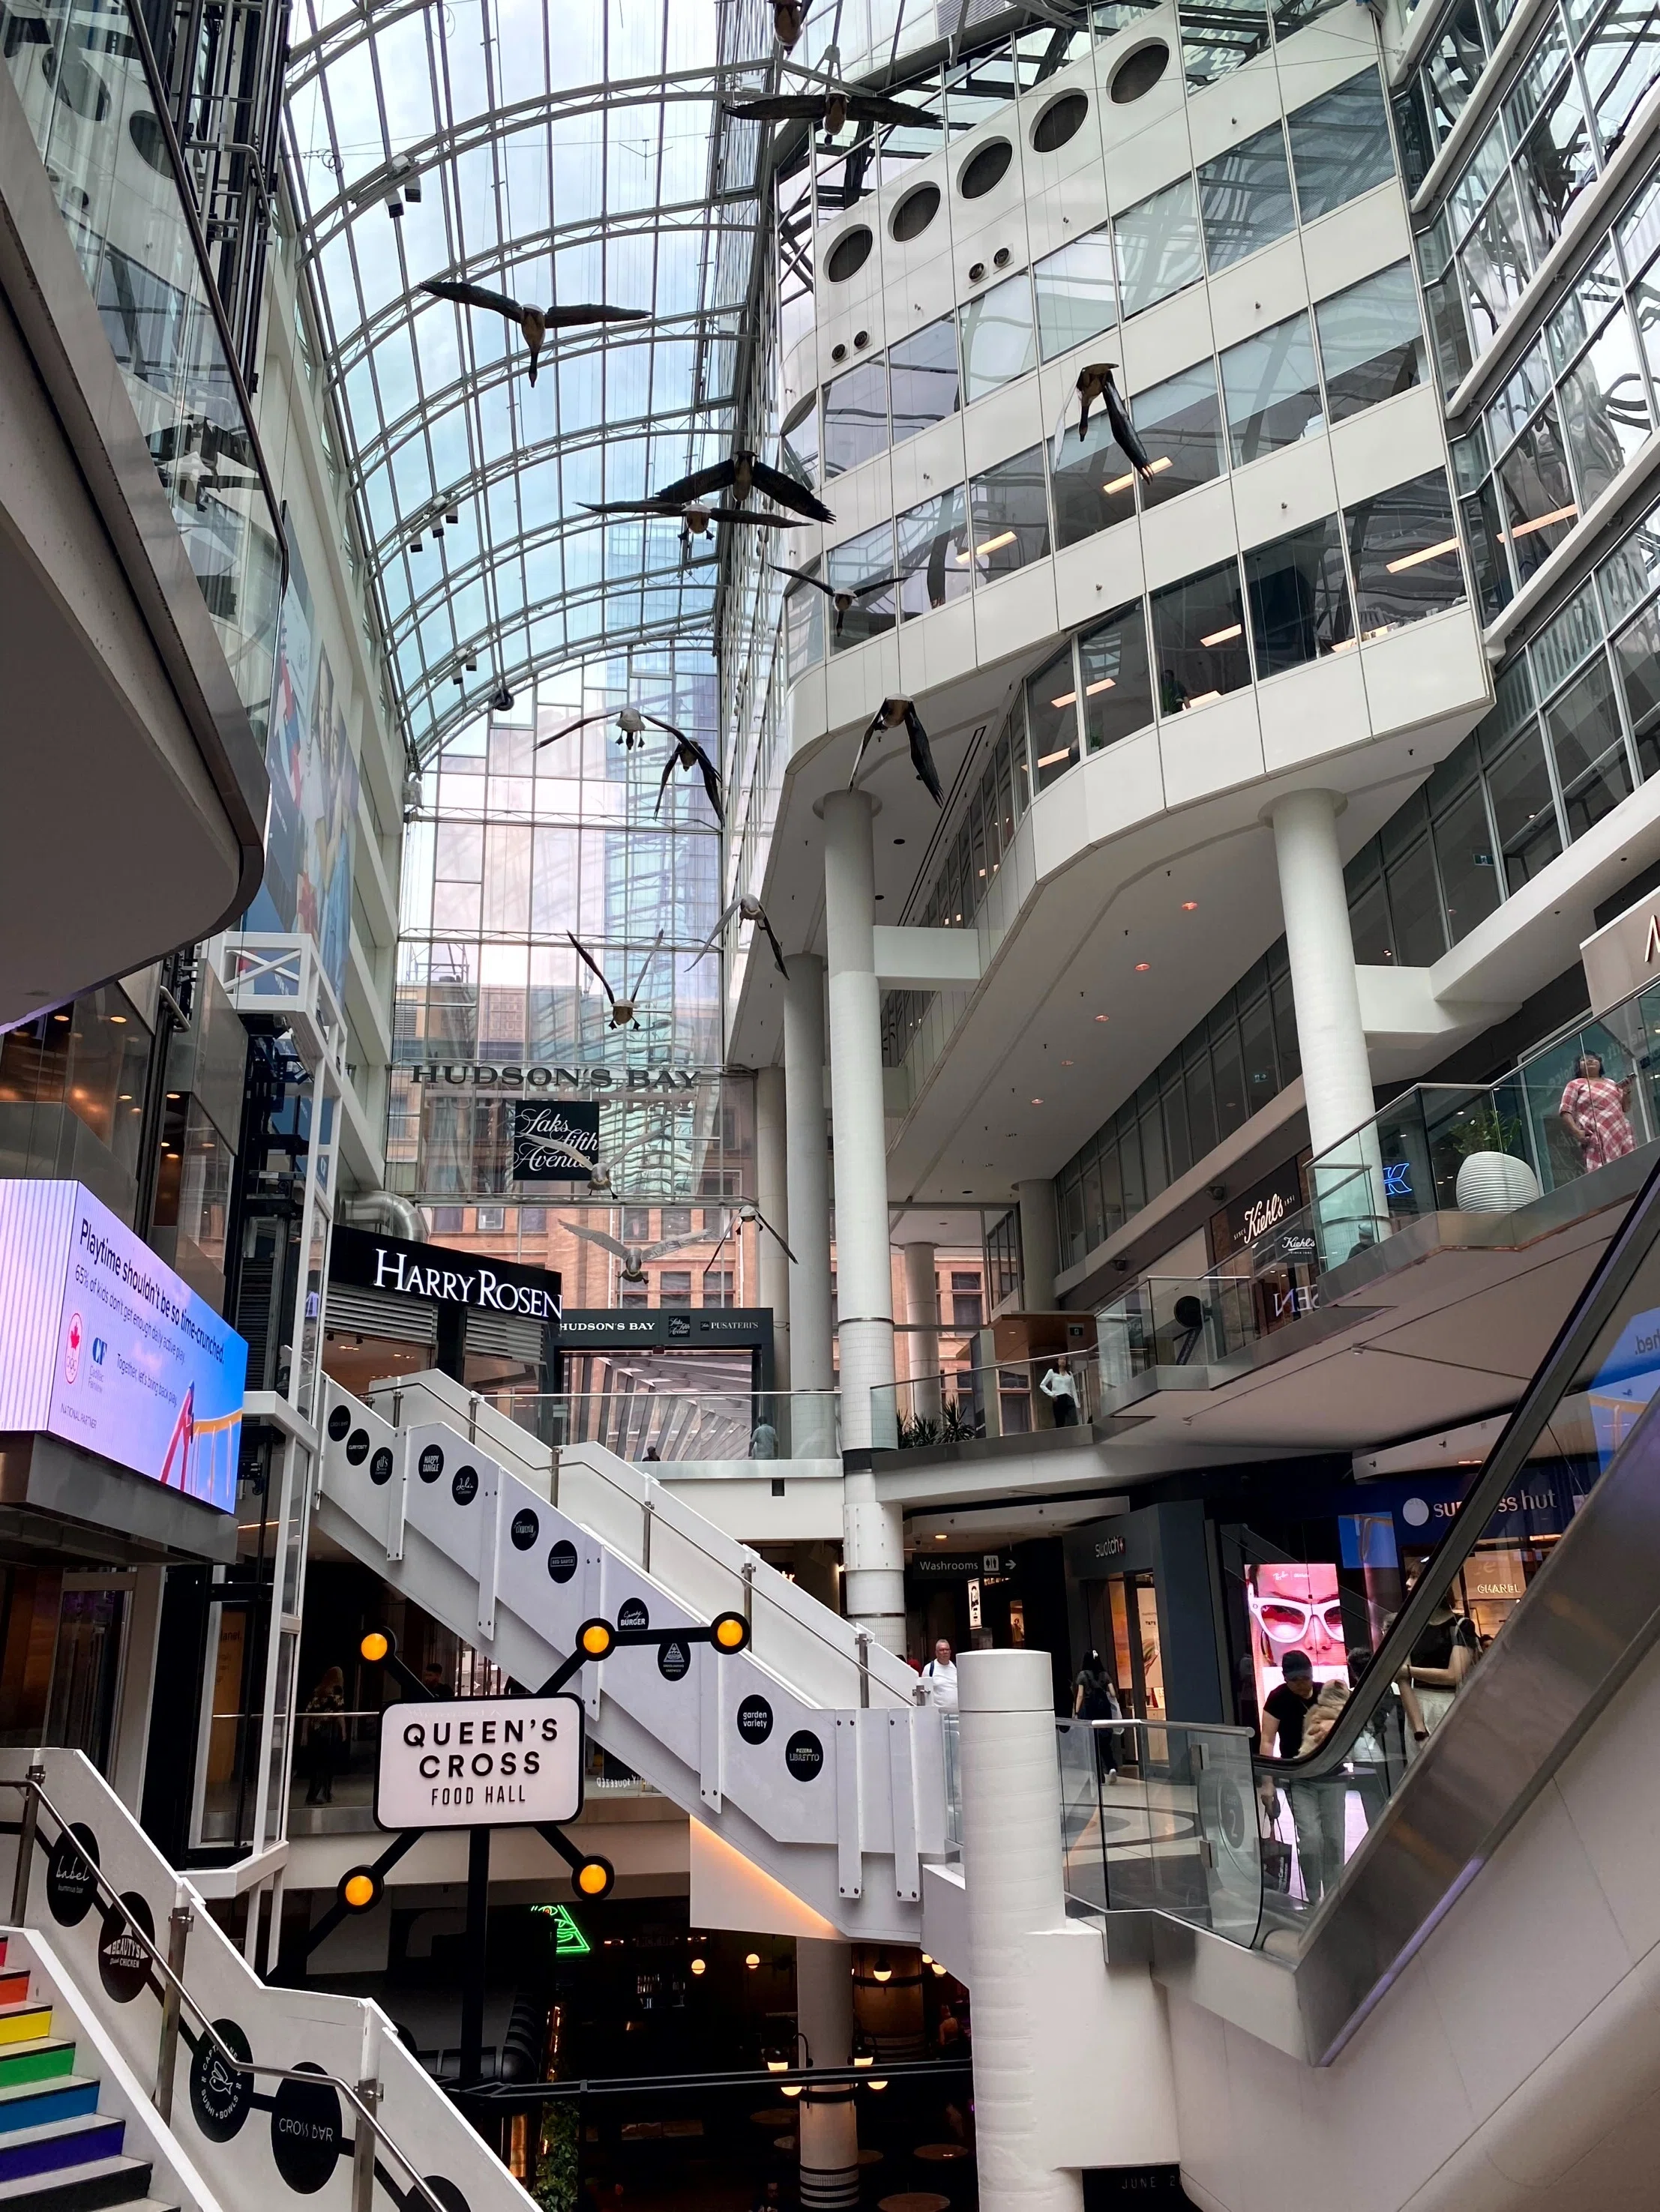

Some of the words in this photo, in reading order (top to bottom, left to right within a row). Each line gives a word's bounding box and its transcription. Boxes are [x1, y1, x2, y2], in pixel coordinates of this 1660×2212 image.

[410, 1065, 613, 1087] HUDSON'S
[626, 1070, 700, 1088] BAY
[1244, 1193, 1284, 1244] Kiehl's
[1281, 1237, 1315, 1248] Kiehl's
[79, 1218, 121, 1276] Playtime
[122, 1259, 160, 1310] shouldn't
[160, 1293, 170, 1318] be
[171, 1305, 180, 1326] so
[181, 1308, 225, 1364] time-crunched.
[374, 1249, 475, 1302] HARRY
[478, 1270, 563, 1319] ROSEN
[75, 1265, 89, 1289] 65%
[90, 1275, 97, 1292] of
[97, 1279, 109, 1304] kids
[109, 1292, 123, 1310] don't
[123, 1307, 133, 1322] get
[133, 1314, 151, 1338] enough
[560, 1322, 625, 1330] HUDSON'S
[629, 1322, 655, 1330] BAY
[711, 1322, 759, 1330] PUSATERI'S
[92, 1337, 107, 1365] CF
[117, 1353, 137, 1382] Together,
[1521, 1489, 1557, 1511] hut
[920, 1561, 978, 1570] Washrooms
[1477, 1583, 1521, 1594] CHANEL
[743, 1711, 766, 1720] garden
[743, 1720, 767, 1729] variety
[403, 1718, 558, 1748] QUEEN'S
[419, 1751, 540, 1779] CROSS
[790, 1753, 820, 1762] LIBRETTO
[432, 1787, 474, 1806] FOOD
[485, 1785, 526, 1803] HALL
[119, 1959, 139, 1968] CHICKEN
[220, 2096, 238, 2119] BOWLS
[1122, 2176, 1157, 2190] JUNE
